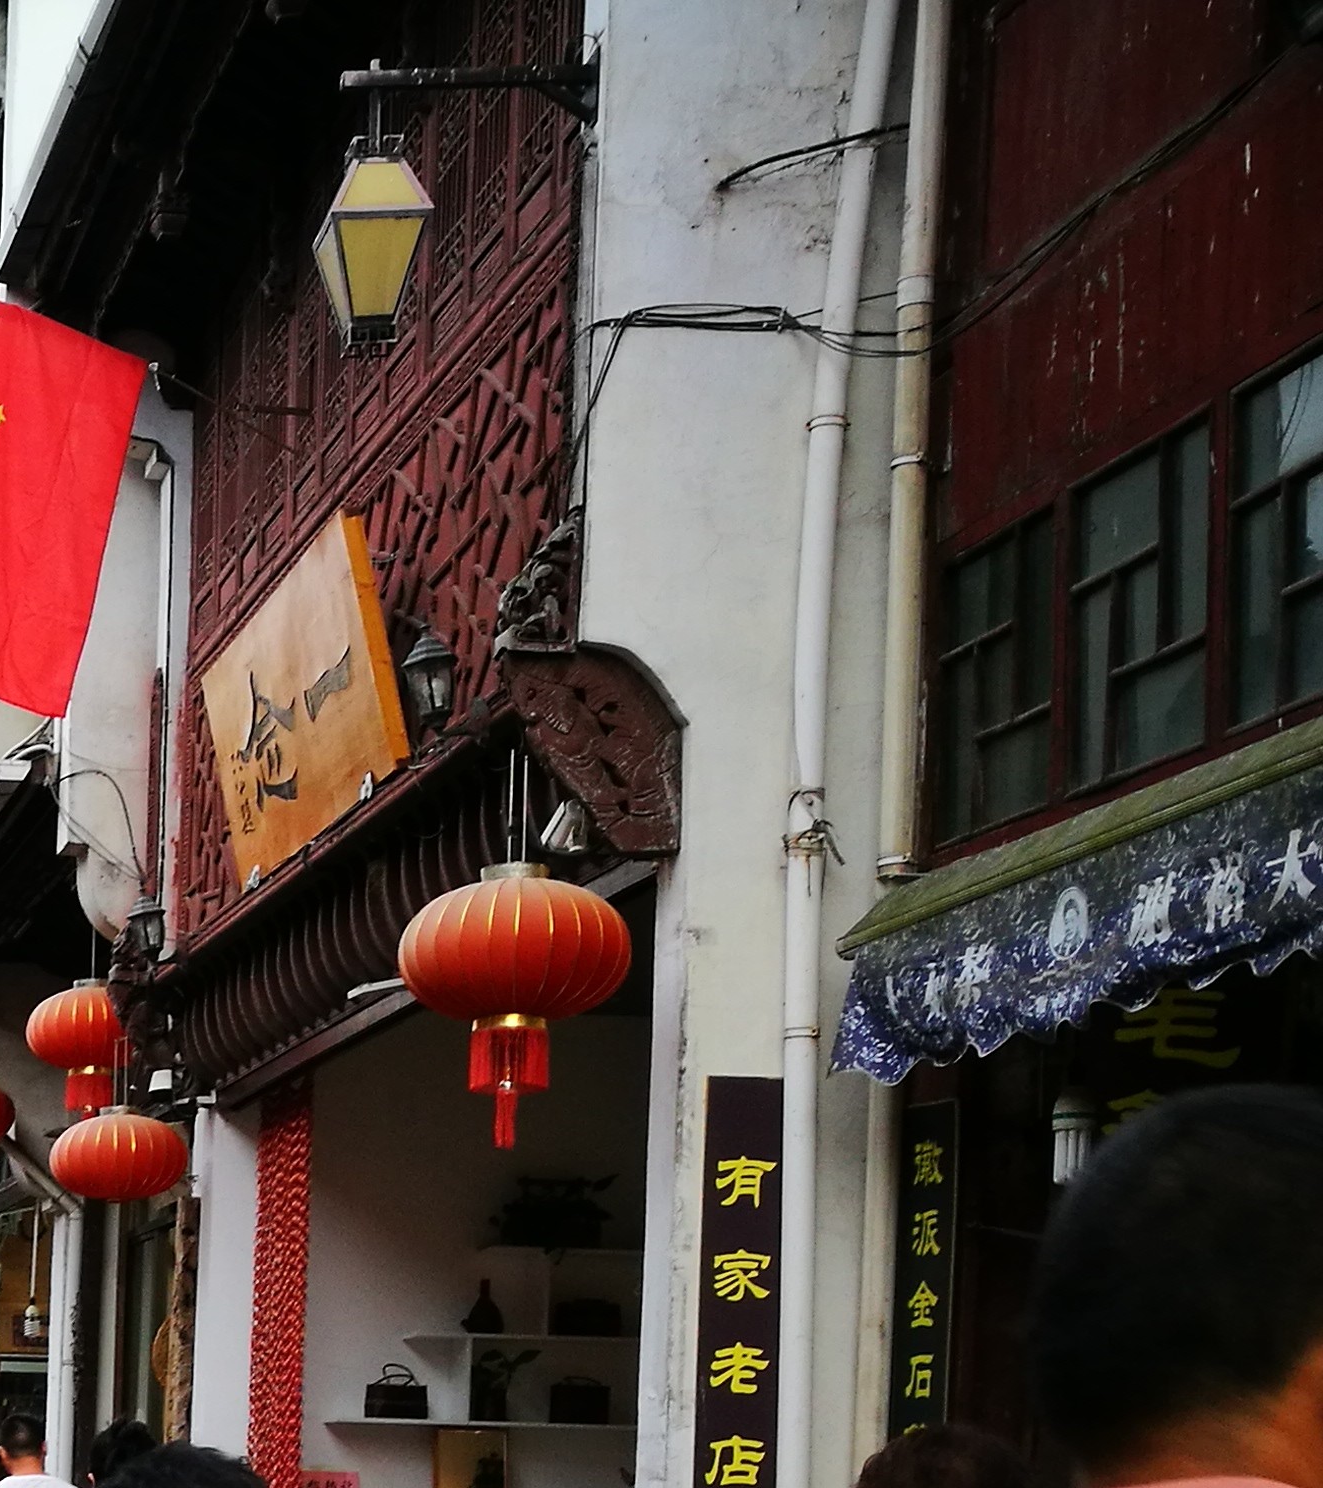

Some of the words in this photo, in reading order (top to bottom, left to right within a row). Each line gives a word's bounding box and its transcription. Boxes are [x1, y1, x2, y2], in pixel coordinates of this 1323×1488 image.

[705, 1155, 778, 1486] 有家老店
[904, 1140, 945, 1435] 徽派金石
